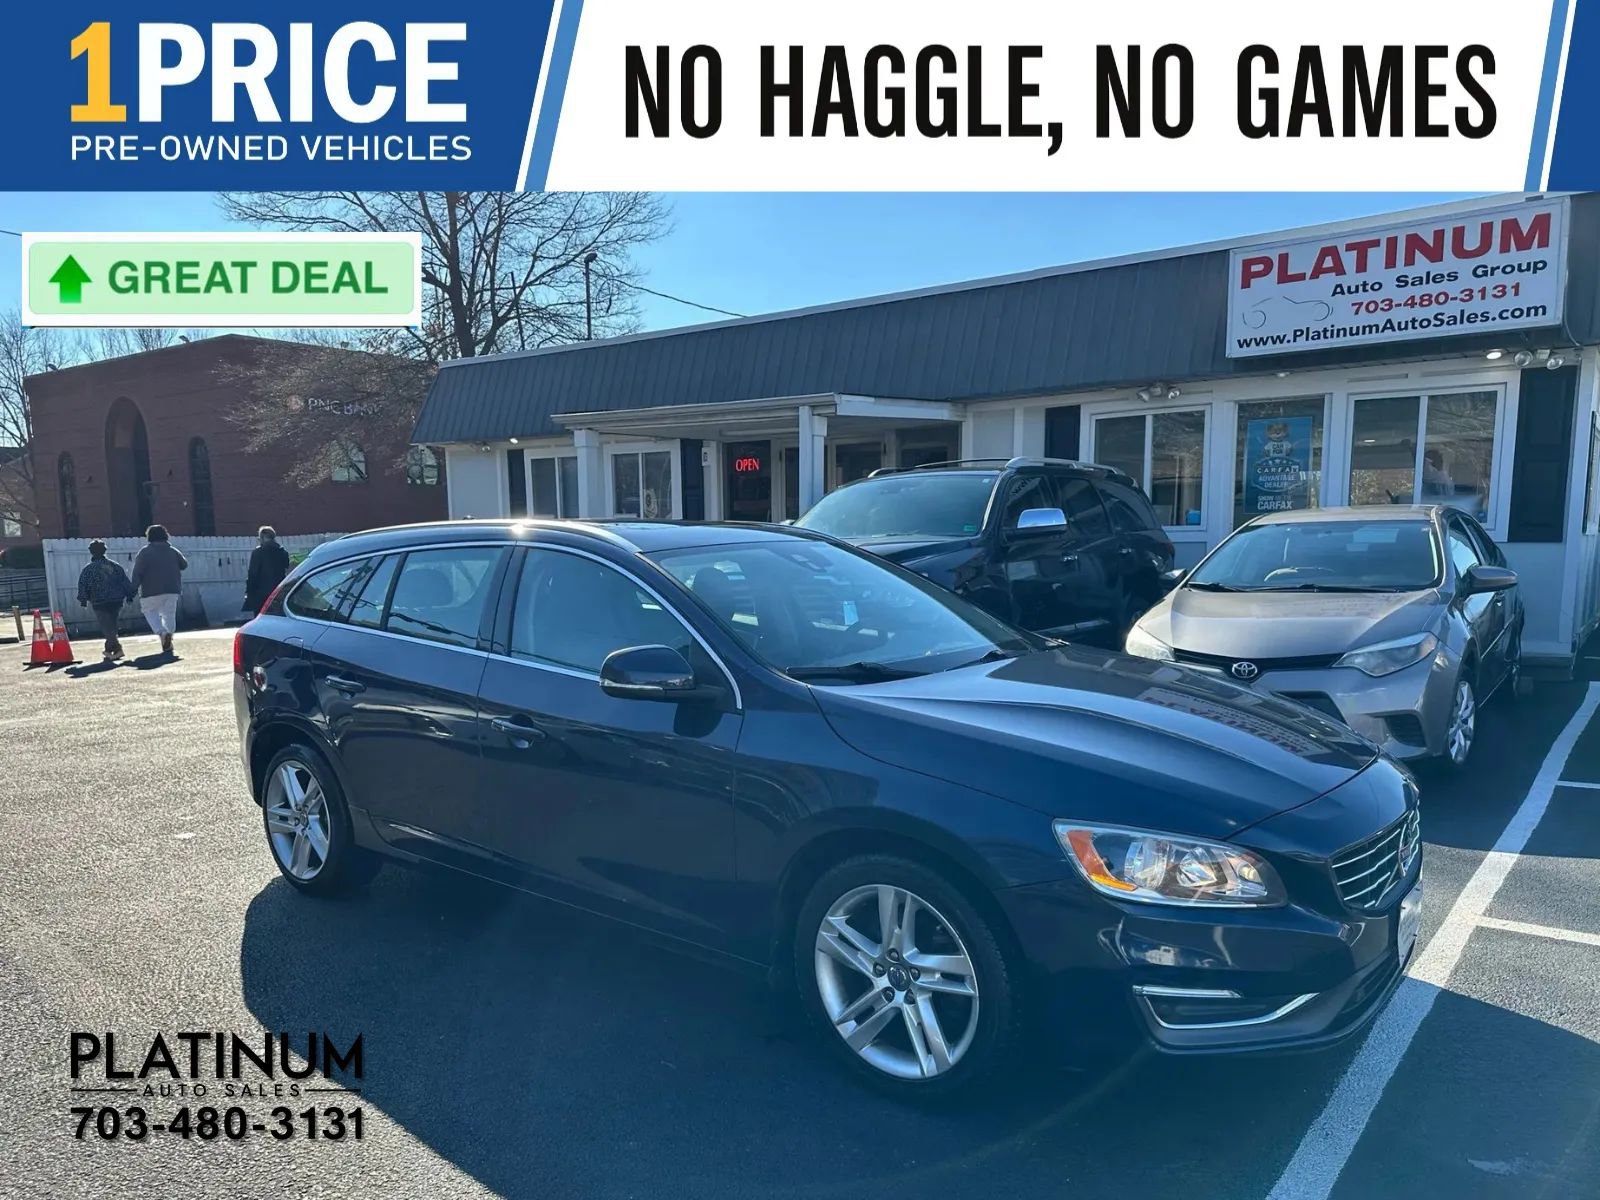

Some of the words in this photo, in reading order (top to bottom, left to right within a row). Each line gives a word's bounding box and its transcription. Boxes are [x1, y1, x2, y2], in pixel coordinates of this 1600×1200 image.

[1241, 213, 1551, 290] PLATINUM
[1331, 280, 1383, 297] Auto
[1395, 269, 1459, 288] Sales
[1472, 259, 1548, 279] Group
[1351, 282, 1521, 315] 703-480-3131
[1237, 302, 1547, 349] www.PlatinumAutoSales.com
[308, 398, 340, 414] PNC
[735, 457, 760, 472] OPEN
[1257, 500, 1293, 510] CARFAX
